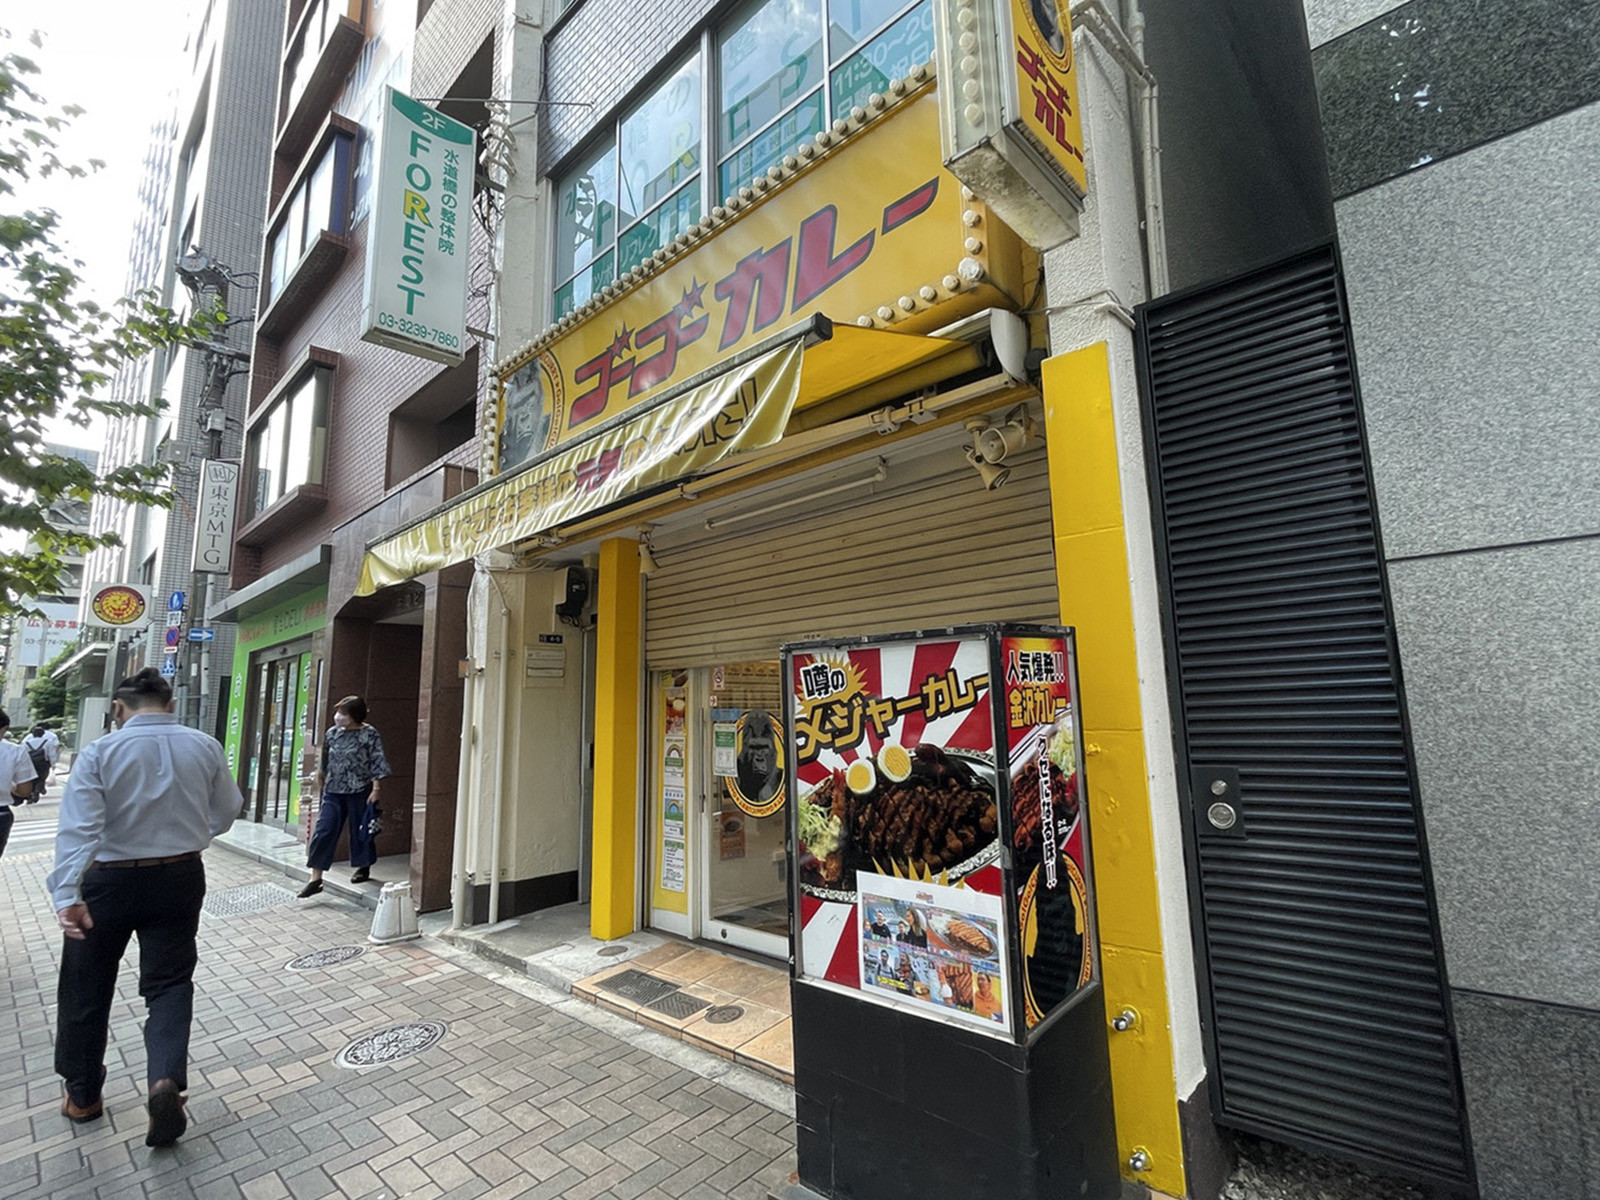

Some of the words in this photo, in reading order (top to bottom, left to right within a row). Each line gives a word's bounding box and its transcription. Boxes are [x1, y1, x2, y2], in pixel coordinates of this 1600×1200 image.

[421, 111, 447, 131] 2F
[397, 130, 434, 316] FOREST
[437, 148, 460, 257] 水道橋の整体院
[378, 312, 459, 349] 03-3239-7860
[203, 485, 230, 565] 東京MTG
[802, 664, 848, 700] 噂の
[1009, 686, 1067, 728] 金沢カレー
[795, 669, 989, 761] メジャーカレー
